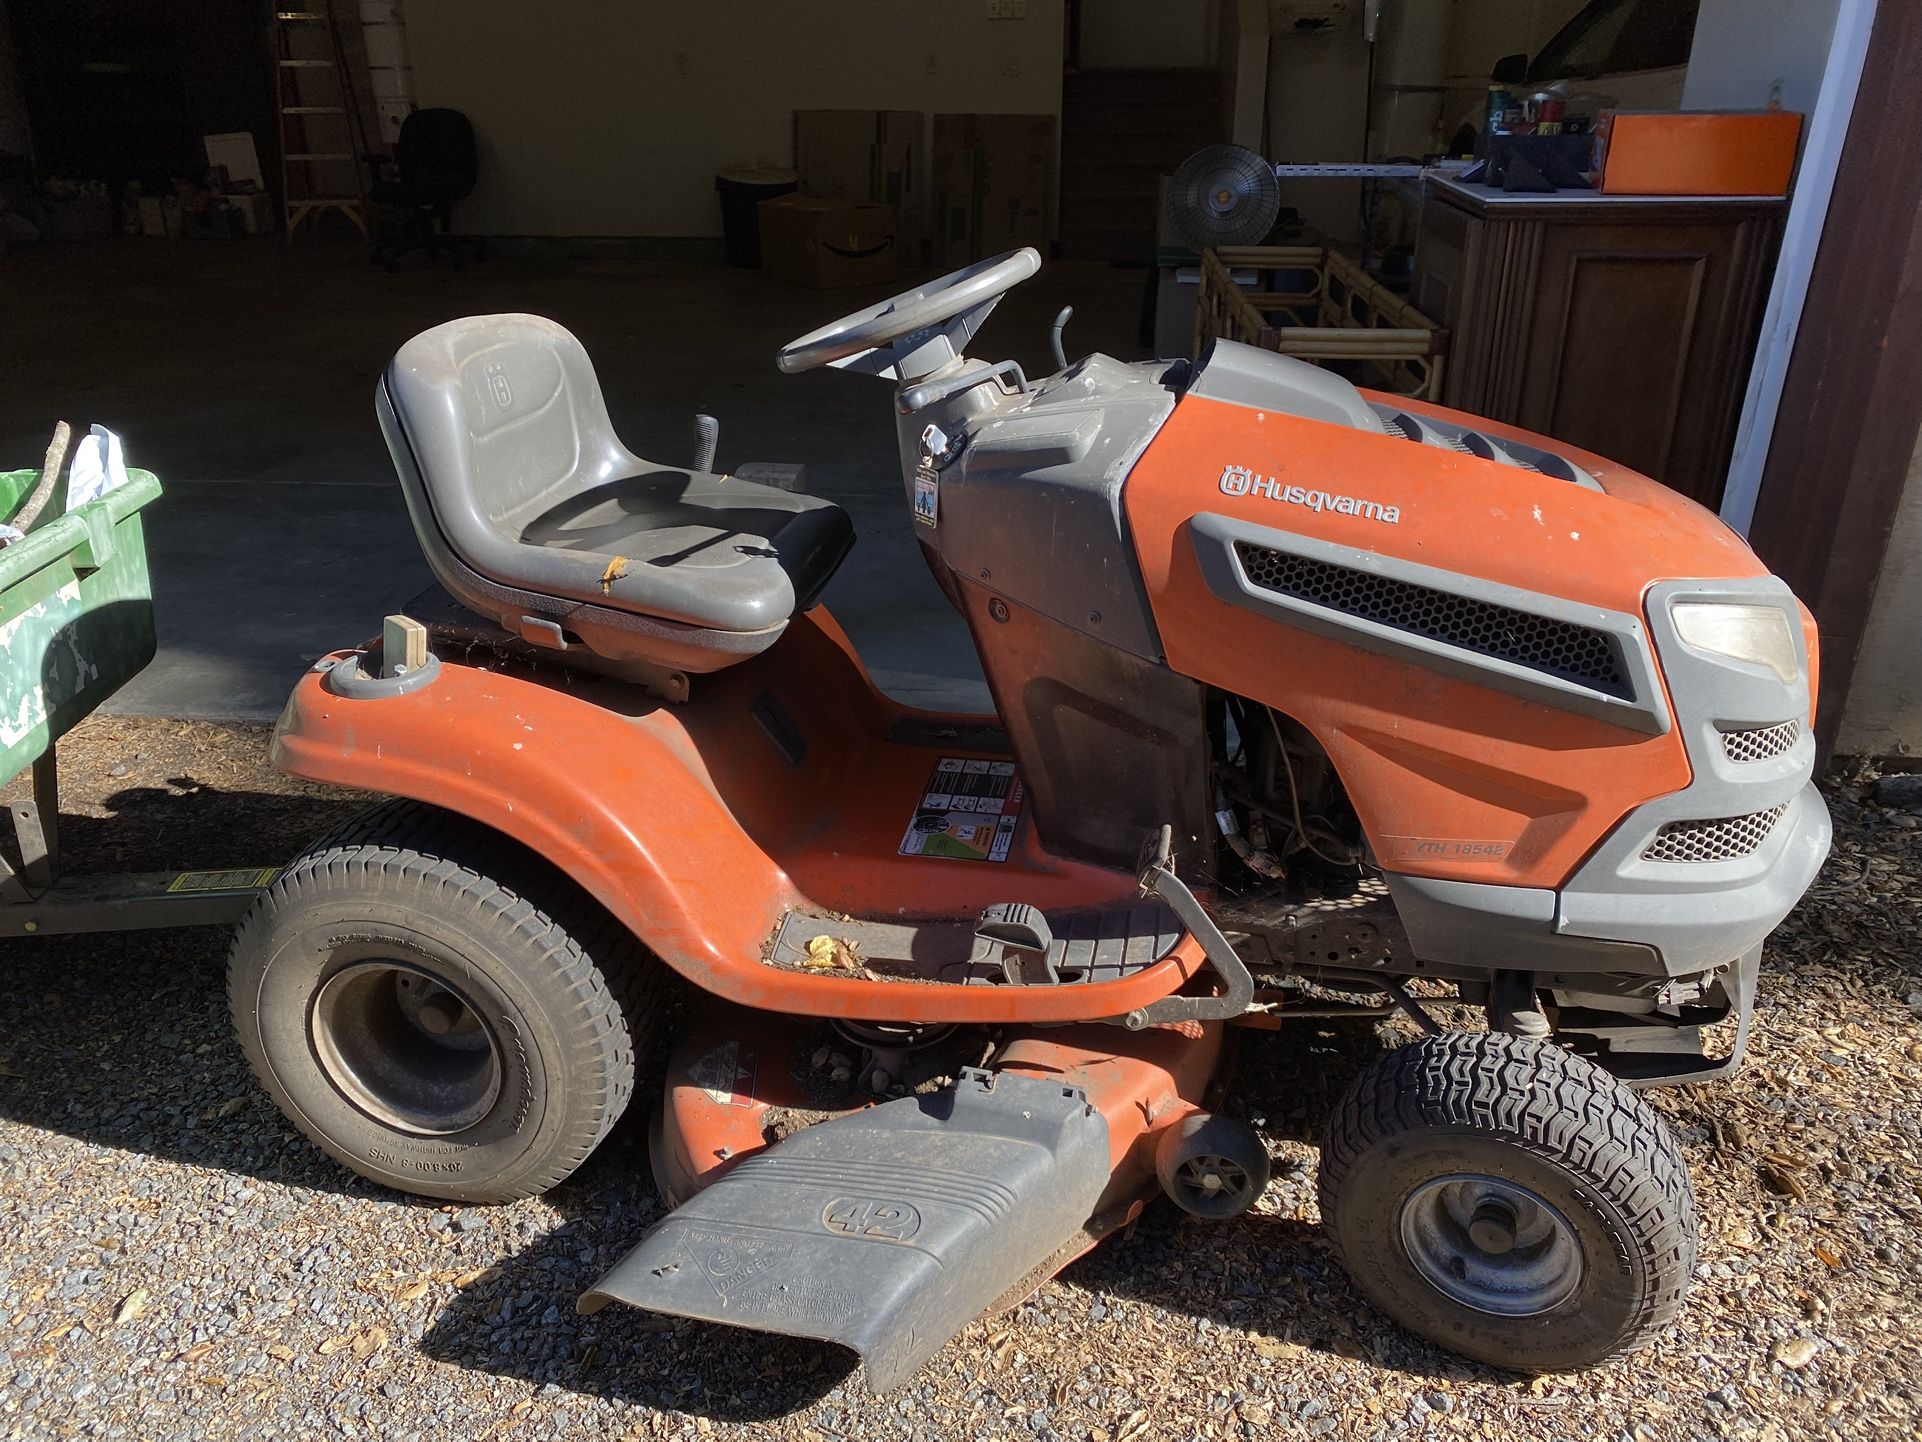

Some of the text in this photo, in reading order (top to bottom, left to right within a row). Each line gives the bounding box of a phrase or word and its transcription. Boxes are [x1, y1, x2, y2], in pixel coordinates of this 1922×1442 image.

[1250, 474, 1400, 524] Husqvarna
[1415, 842, 1505, 855] YTH 18542
[368, 1146, 396, 1165] NHS
[828, 1199, 912, 1240] 42
[718, 1254, 773, 1290] DANGER
[792, 1273, 822, 1288] CAUTION
[740, 1289, 768, 1301] ENTIRE
[769, 1292, 795, 1306] GRASS
[797, 1295, 832, 1311] CATCHER
[771, 1282, 856, 1302] DEECTOR SHIELD OR
